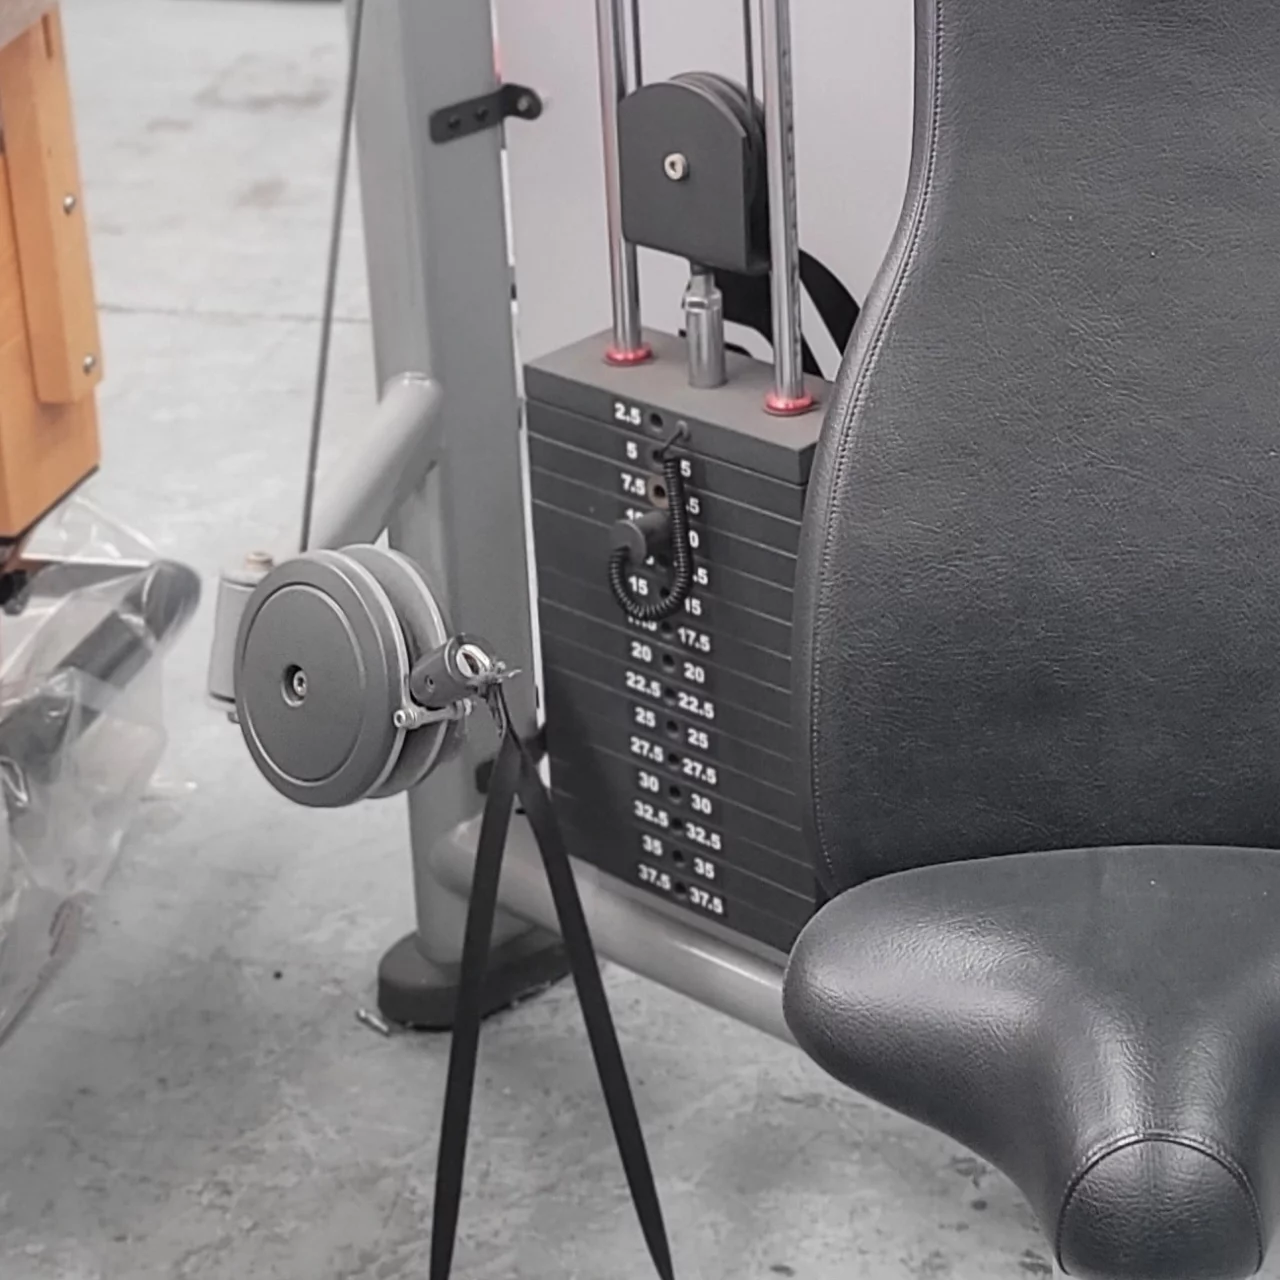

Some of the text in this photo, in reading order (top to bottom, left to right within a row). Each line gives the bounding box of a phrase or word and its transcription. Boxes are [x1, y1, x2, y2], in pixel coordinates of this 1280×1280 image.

[614, 402, 641, 425] 2.5
[626, 441, 638, 459] 5
[680, 460, 692, 477] 5
[621, 472, 646, 495] 7.5
[628, 576, 648, 595] 15
[685, 597, 702, 616] 15
[677, 627, 711, 652] 17.5
[631, 641, 652, 662] 20
[684, 662, 705, 683] 20
[625, 671, 661, 697] 22.5
[677, 692, 714, 719] 22.5
[634, 707, 656, 727] 25
[630, 736, 664, 762] 27.5
[687, 728, 709, 749] 25
[638, 771, 660, 792] 30
[682, 758, 717, 784] 27.5
[634, 800, 669, 827] 32.5
[691, 793, 712, 814] 30
[642, 835, 663, 856] 35
[685, 823, 721, 850] 32.5
[638, 864, 671, 889] 37.5
[694, 858, 715, 879] 35
[689, 887, 723, 913] 37.5
